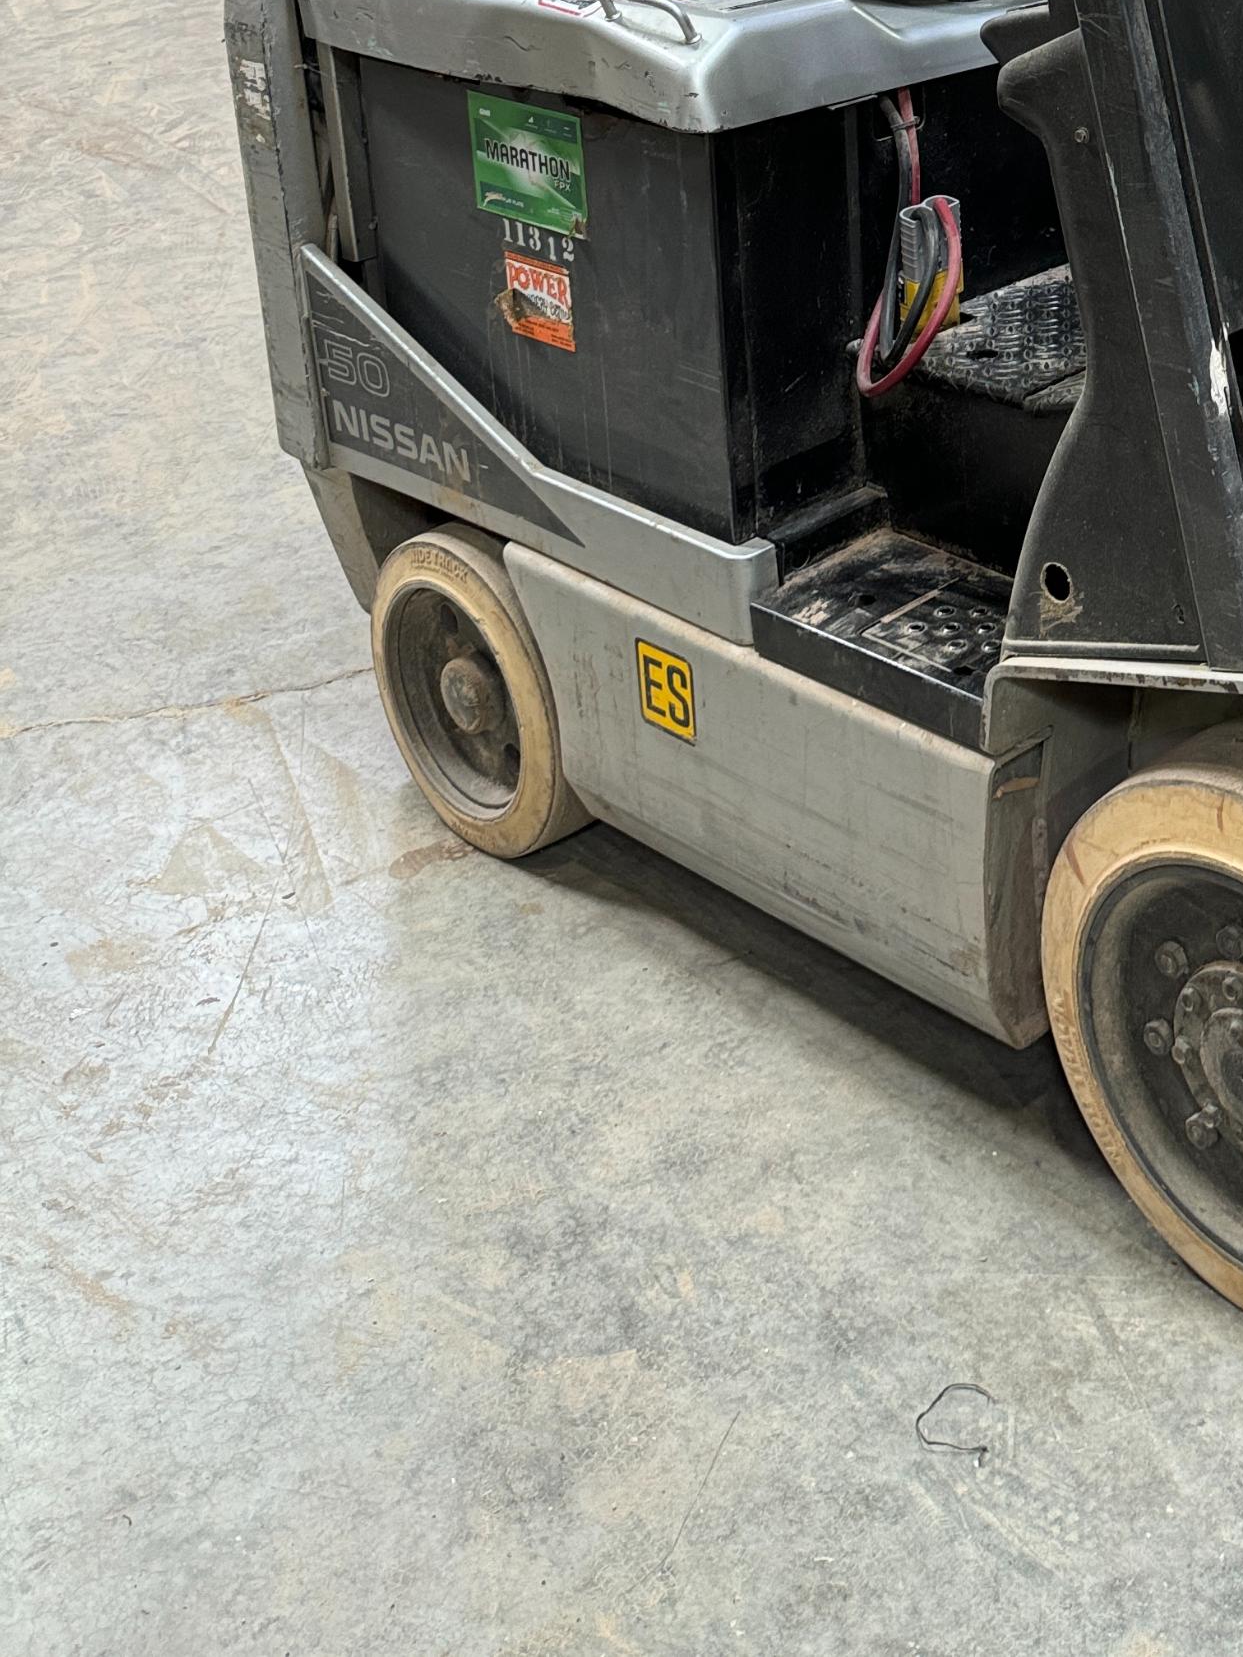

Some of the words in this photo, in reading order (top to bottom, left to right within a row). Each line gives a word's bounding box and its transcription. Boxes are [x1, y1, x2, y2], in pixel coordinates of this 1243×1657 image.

[484, 138, 572, 183] MARATHON
[502, 218, 575, 262] 11312
[507, 261, 572, 311] POWER
[323, 339, 390, 398] 50
[333, 399, 472, 483] NISSAN
[642, 653, 691, 729] ES
